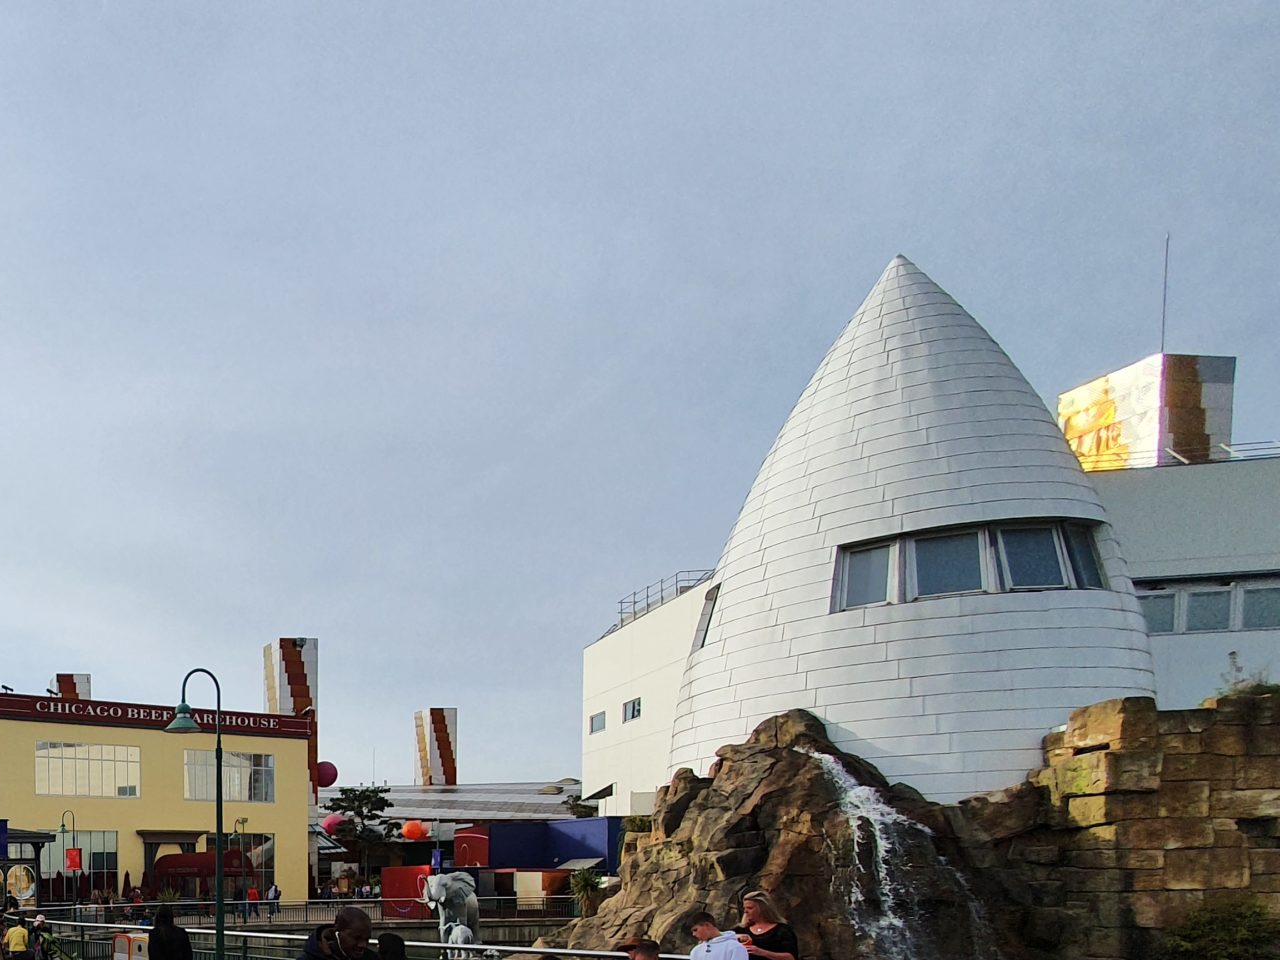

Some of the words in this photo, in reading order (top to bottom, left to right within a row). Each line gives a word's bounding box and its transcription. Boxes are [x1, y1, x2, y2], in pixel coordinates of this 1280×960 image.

[36, 701, 122, 718] CHICAGO
[127, 708, 173, 721] BEEF
[192, 713, 280, 729] AREHOUSE
